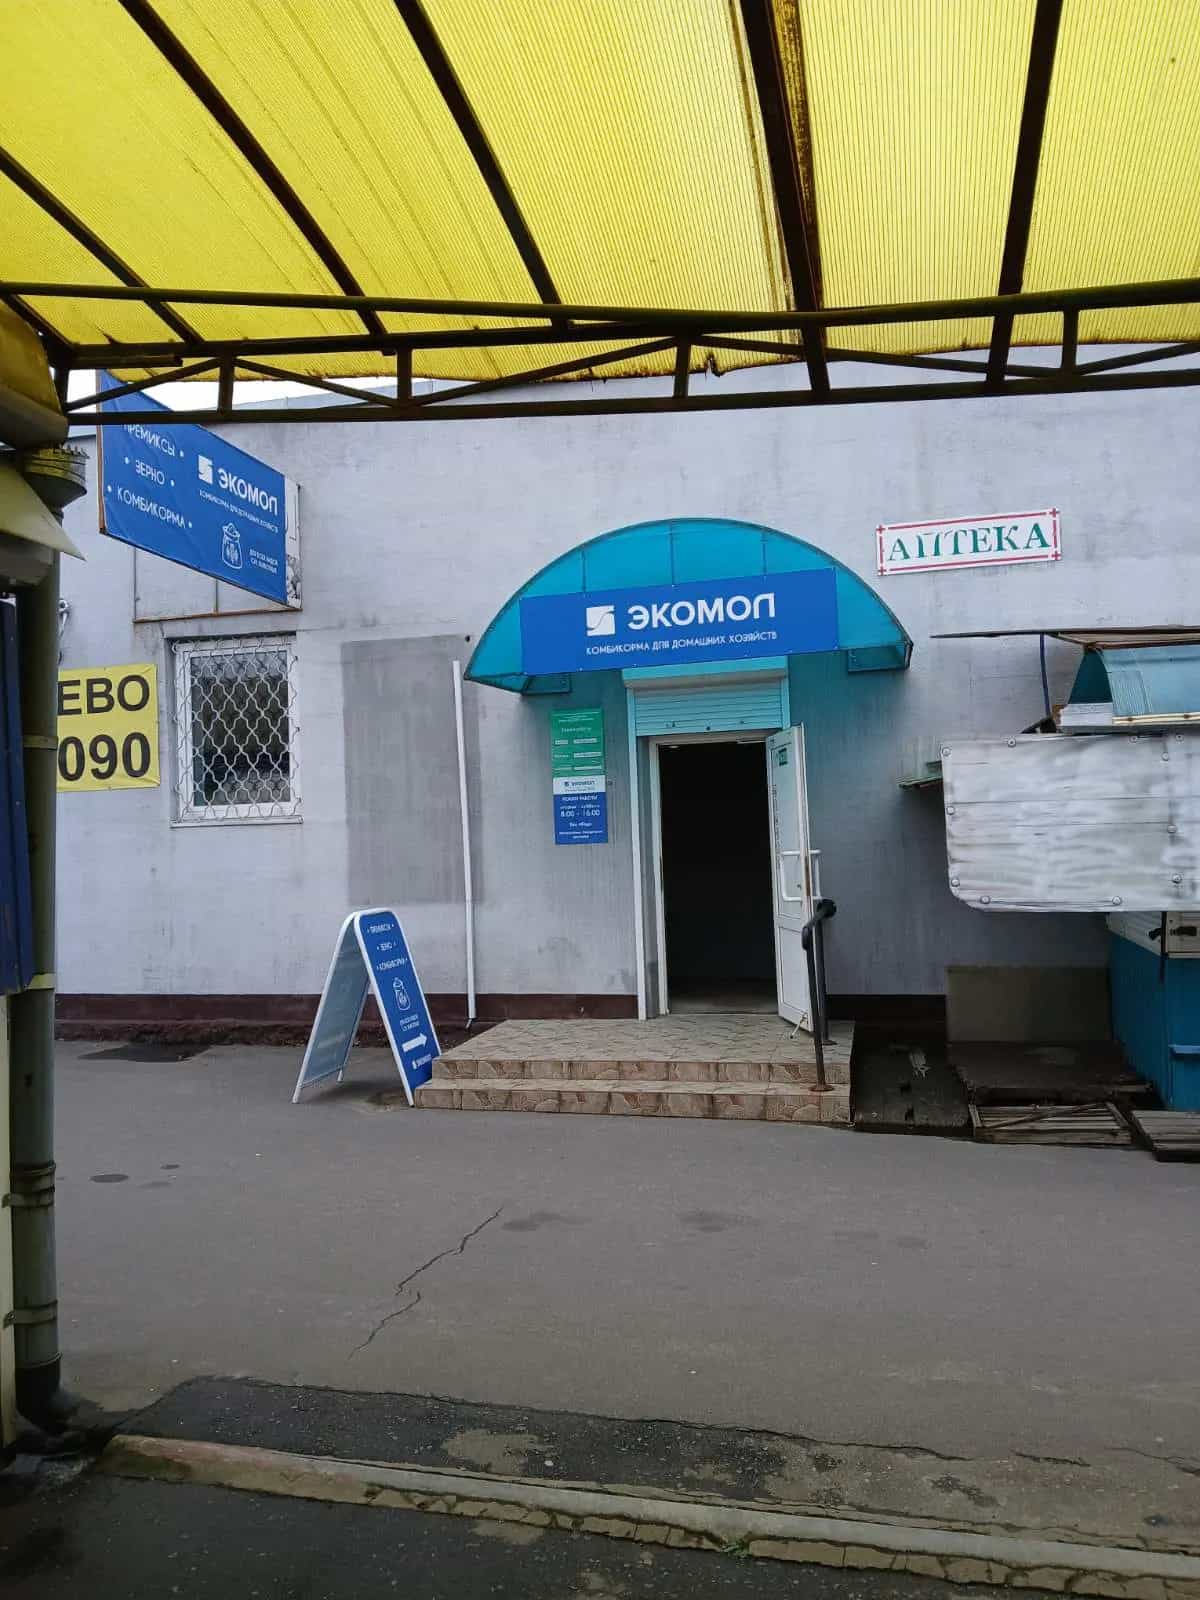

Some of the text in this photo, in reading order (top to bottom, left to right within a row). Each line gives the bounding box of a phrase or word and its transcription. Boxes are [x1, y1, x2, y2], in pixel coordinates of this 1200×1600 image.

[135, 459, 165, 485] ЗЕРНО
[117, 486, 186, 528] КОМБИКОРМА
[888, 522, 1052, 561] АПТЕКА
[586, 642, 650, 656] КОМБИКОРМА
[671, 635, 726, 650] ДОМАШНИХ
[729, 631, 778, 644] ХОЗЯЙСТВ
[58, 732, 151, 782] 090
